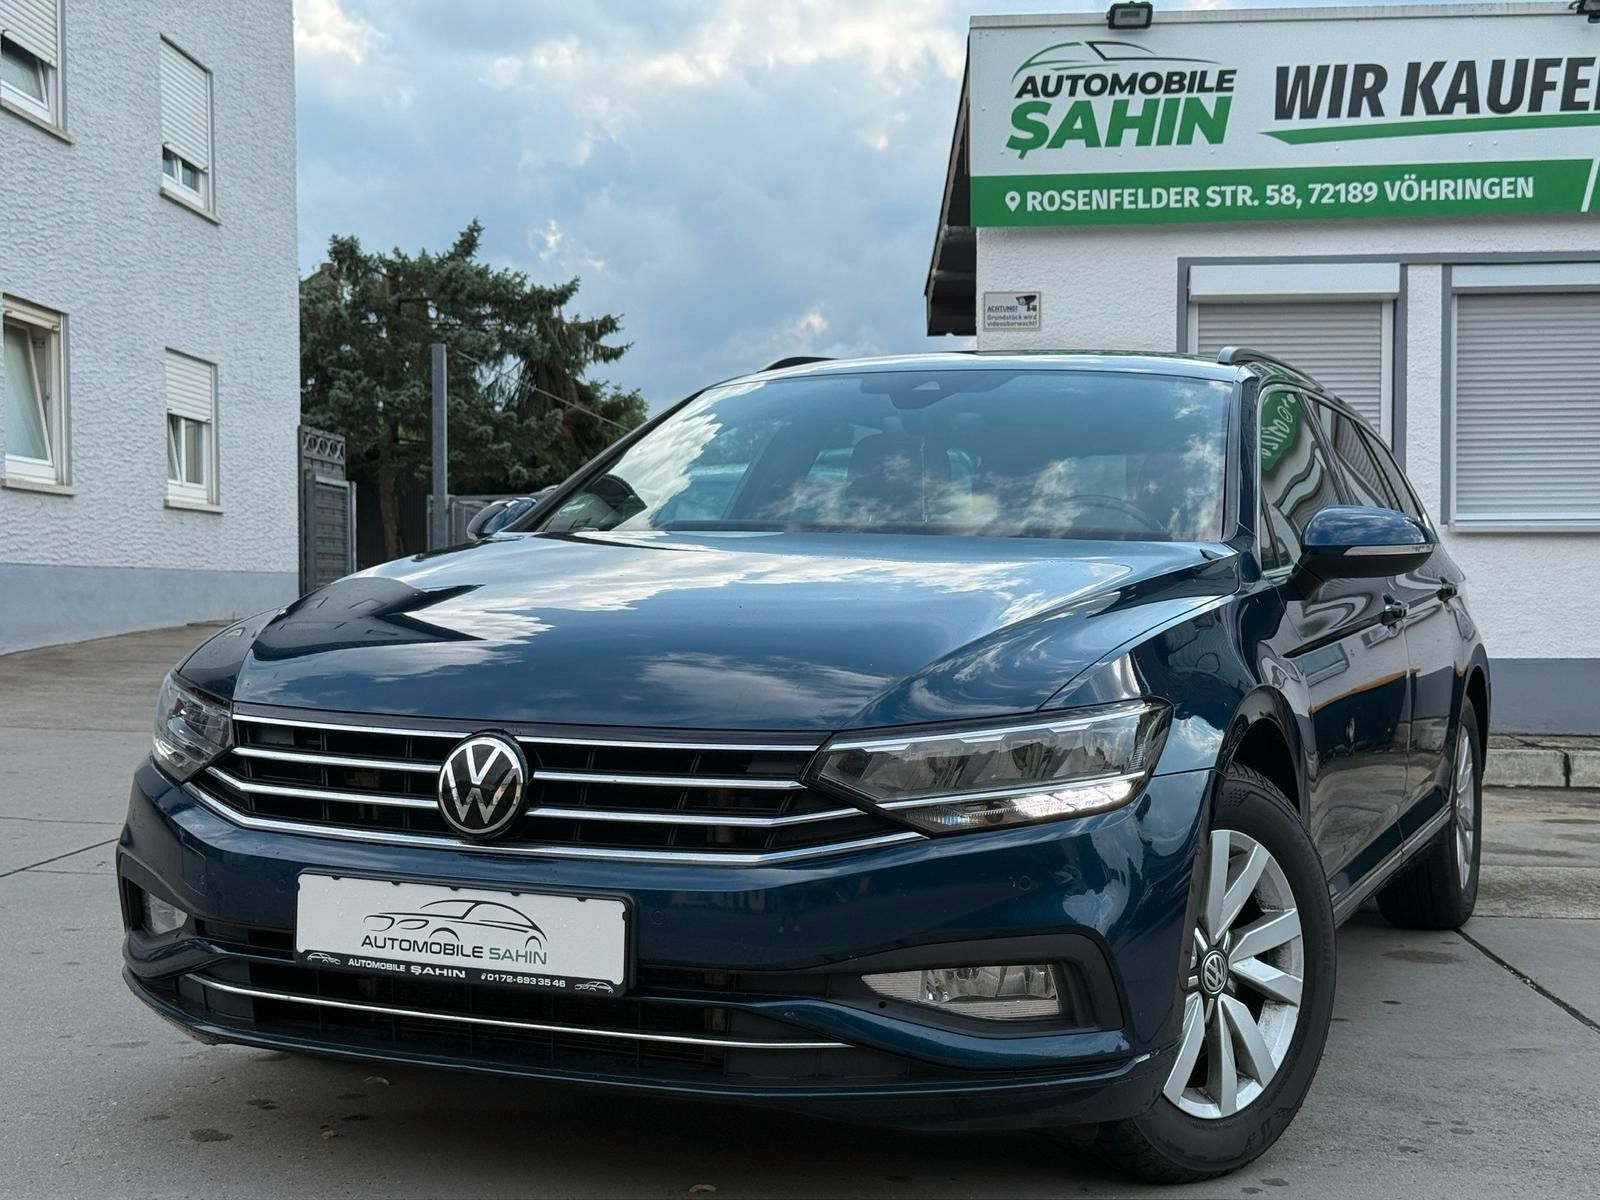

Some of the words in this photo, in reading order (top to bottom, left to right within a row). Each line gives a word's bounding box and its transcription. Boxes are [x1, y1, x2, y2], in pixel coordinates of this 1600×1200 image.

[1015, 69, 1237, 98] AUTOMOBILE
[1274, 63, 1389, 121] WIR
[1400, 57, 1600, 116] KAUFE
[1006, 96, 1233, 159] ŞAHIN
[1026, 186, 1200, 212] ROSENFELDER
[1205, 185, 1259, 207] STR.
[1265, 184, 1303, 209] 58,
[1308, 182, 1378, 205] 72189
[1384, 174, 1534, 202] VÖHRINGEN
[987, 305, 1018, 313] ACHTUNG!
[439, 737, 523, 833] VW
[361, 935, 483, 959] AUTOMOBILE
[489, 947, 547, 965] SAHIN
[348, 958, 406, 972] AUTOMOBILE
[411, 964, 466, 978] ŞAHIN
